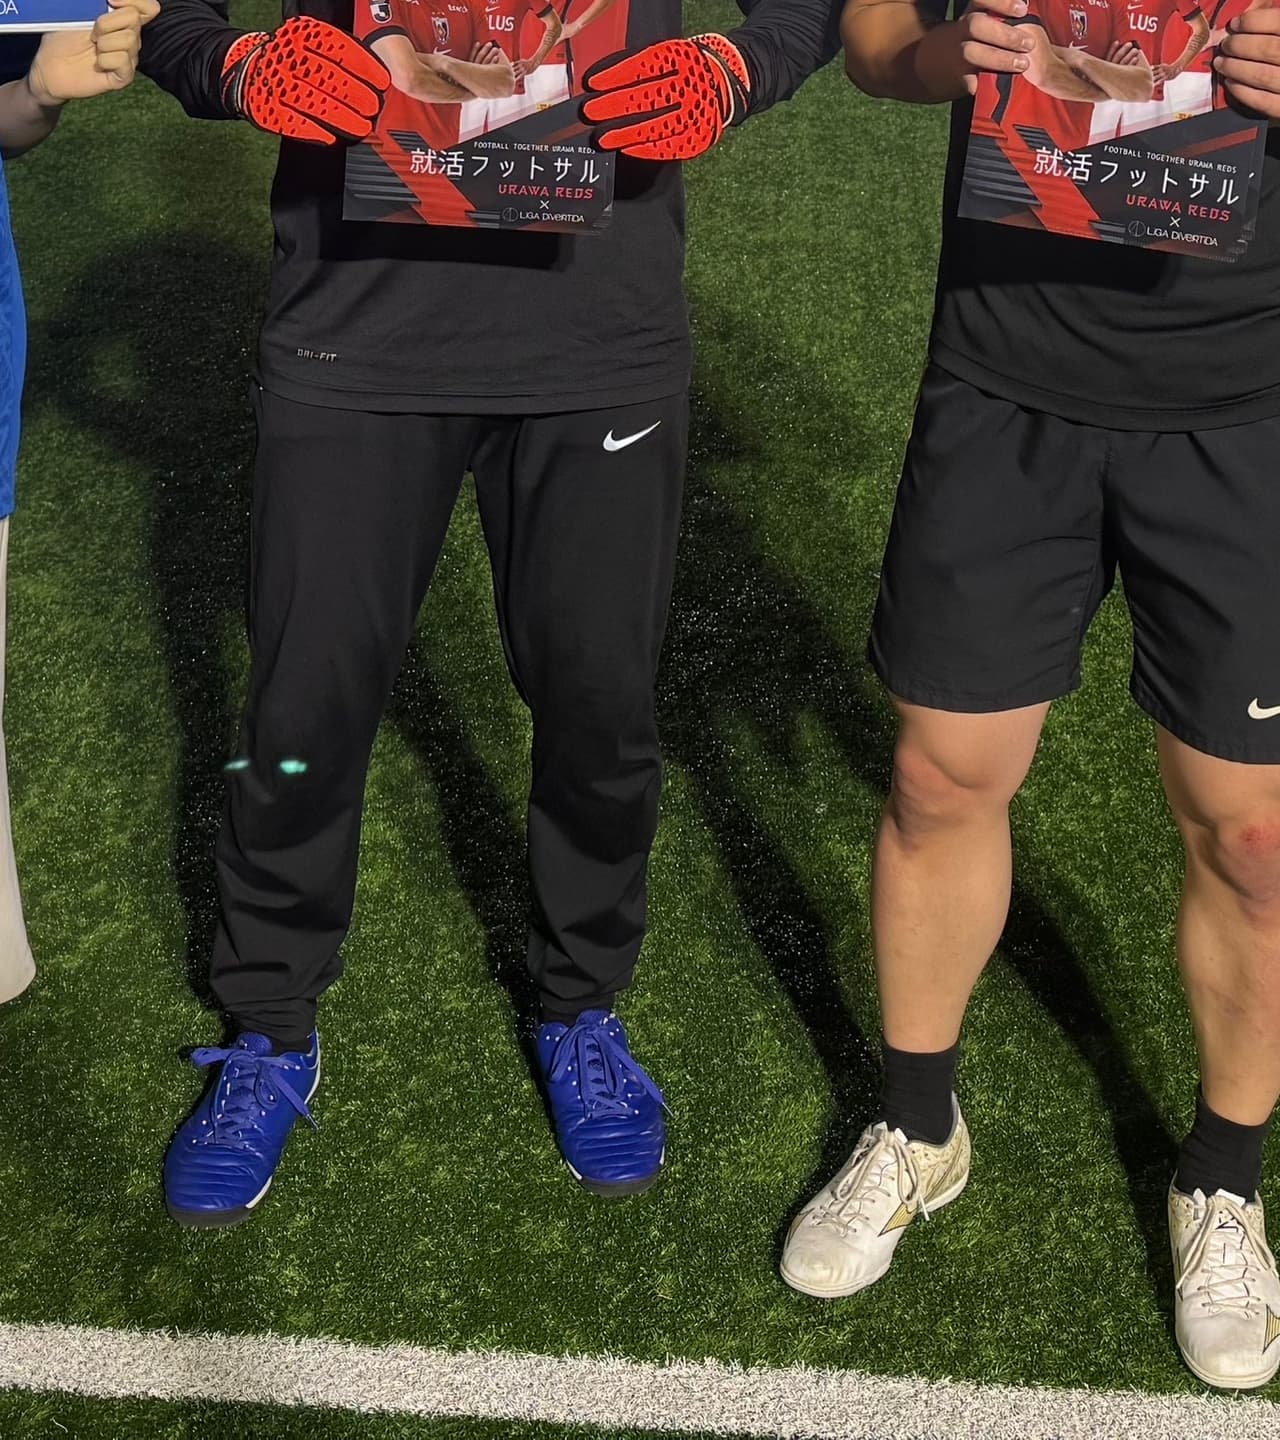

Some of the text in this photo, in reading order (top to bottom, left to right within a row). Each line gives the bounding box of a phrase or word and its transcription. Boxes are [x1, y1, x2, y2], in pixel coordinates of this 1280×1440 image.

[486, 14, 515, 32] LUS
[1127, 12, 1159, 33] LUS
[473, 141, 509, 150] FOOTBALL
[513, 143, 549, 152] TOGETHER
[552, 145, 575, 153] URAWA
[409, 147, 600, 184] 就活フットサル
[1103, 144, 1237, 174] FOOTBALL TOGETHER URAWA REDS
[1033, 146, 1240, 206] 就活フットサル
[498, 184, 594, 199] URAWA REDS
[1125, 193, 1232, 223] URAWA REDS
[297, 348, 337, 362] DRI-FIT
